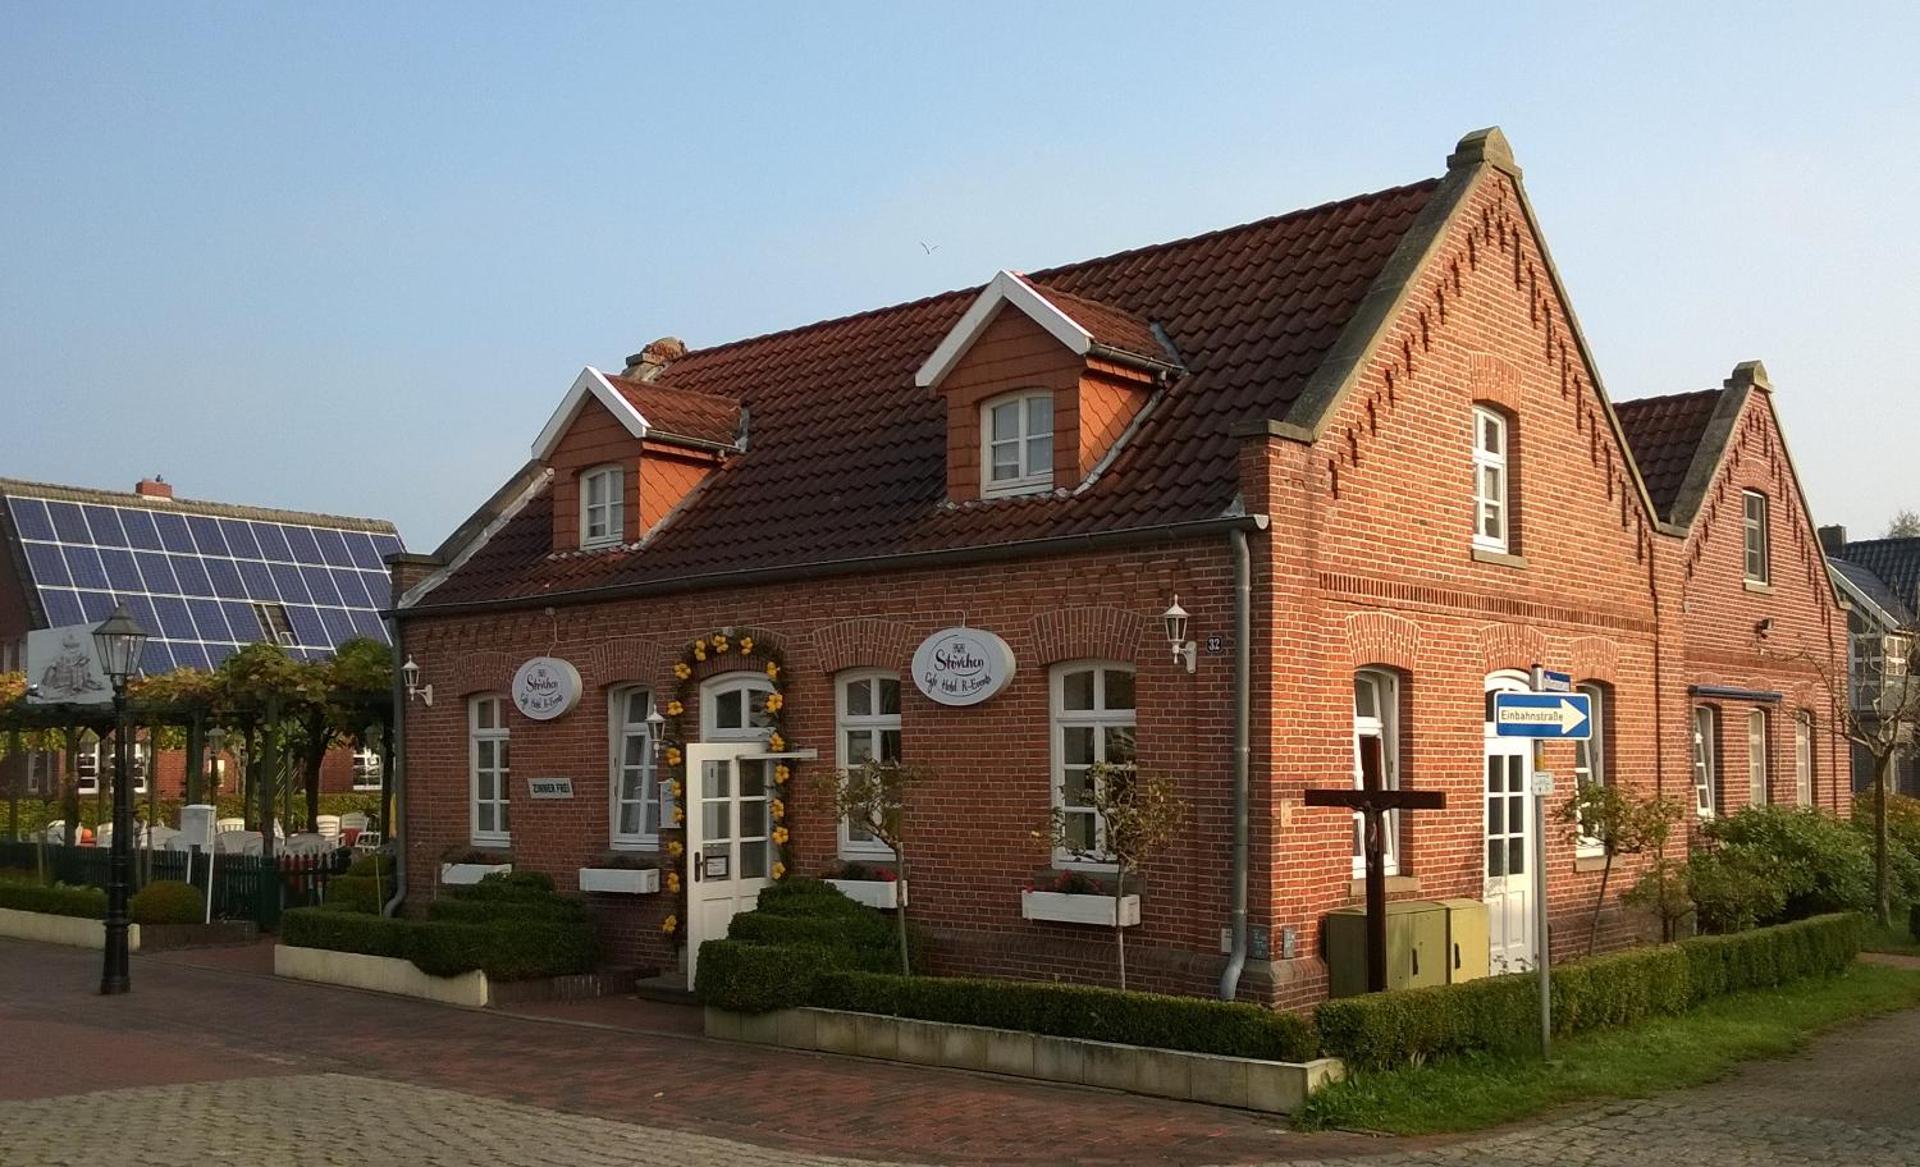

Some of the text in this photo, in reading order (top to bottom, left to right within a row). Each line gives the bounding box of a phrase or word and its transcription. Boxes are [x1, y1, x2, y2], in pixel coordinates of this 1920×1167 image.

[1208, 638, 1221, 651] 32
[934, 649, 984, 671] Stövchen
[1501, 709, 1564, 722] Einbahnstraße
